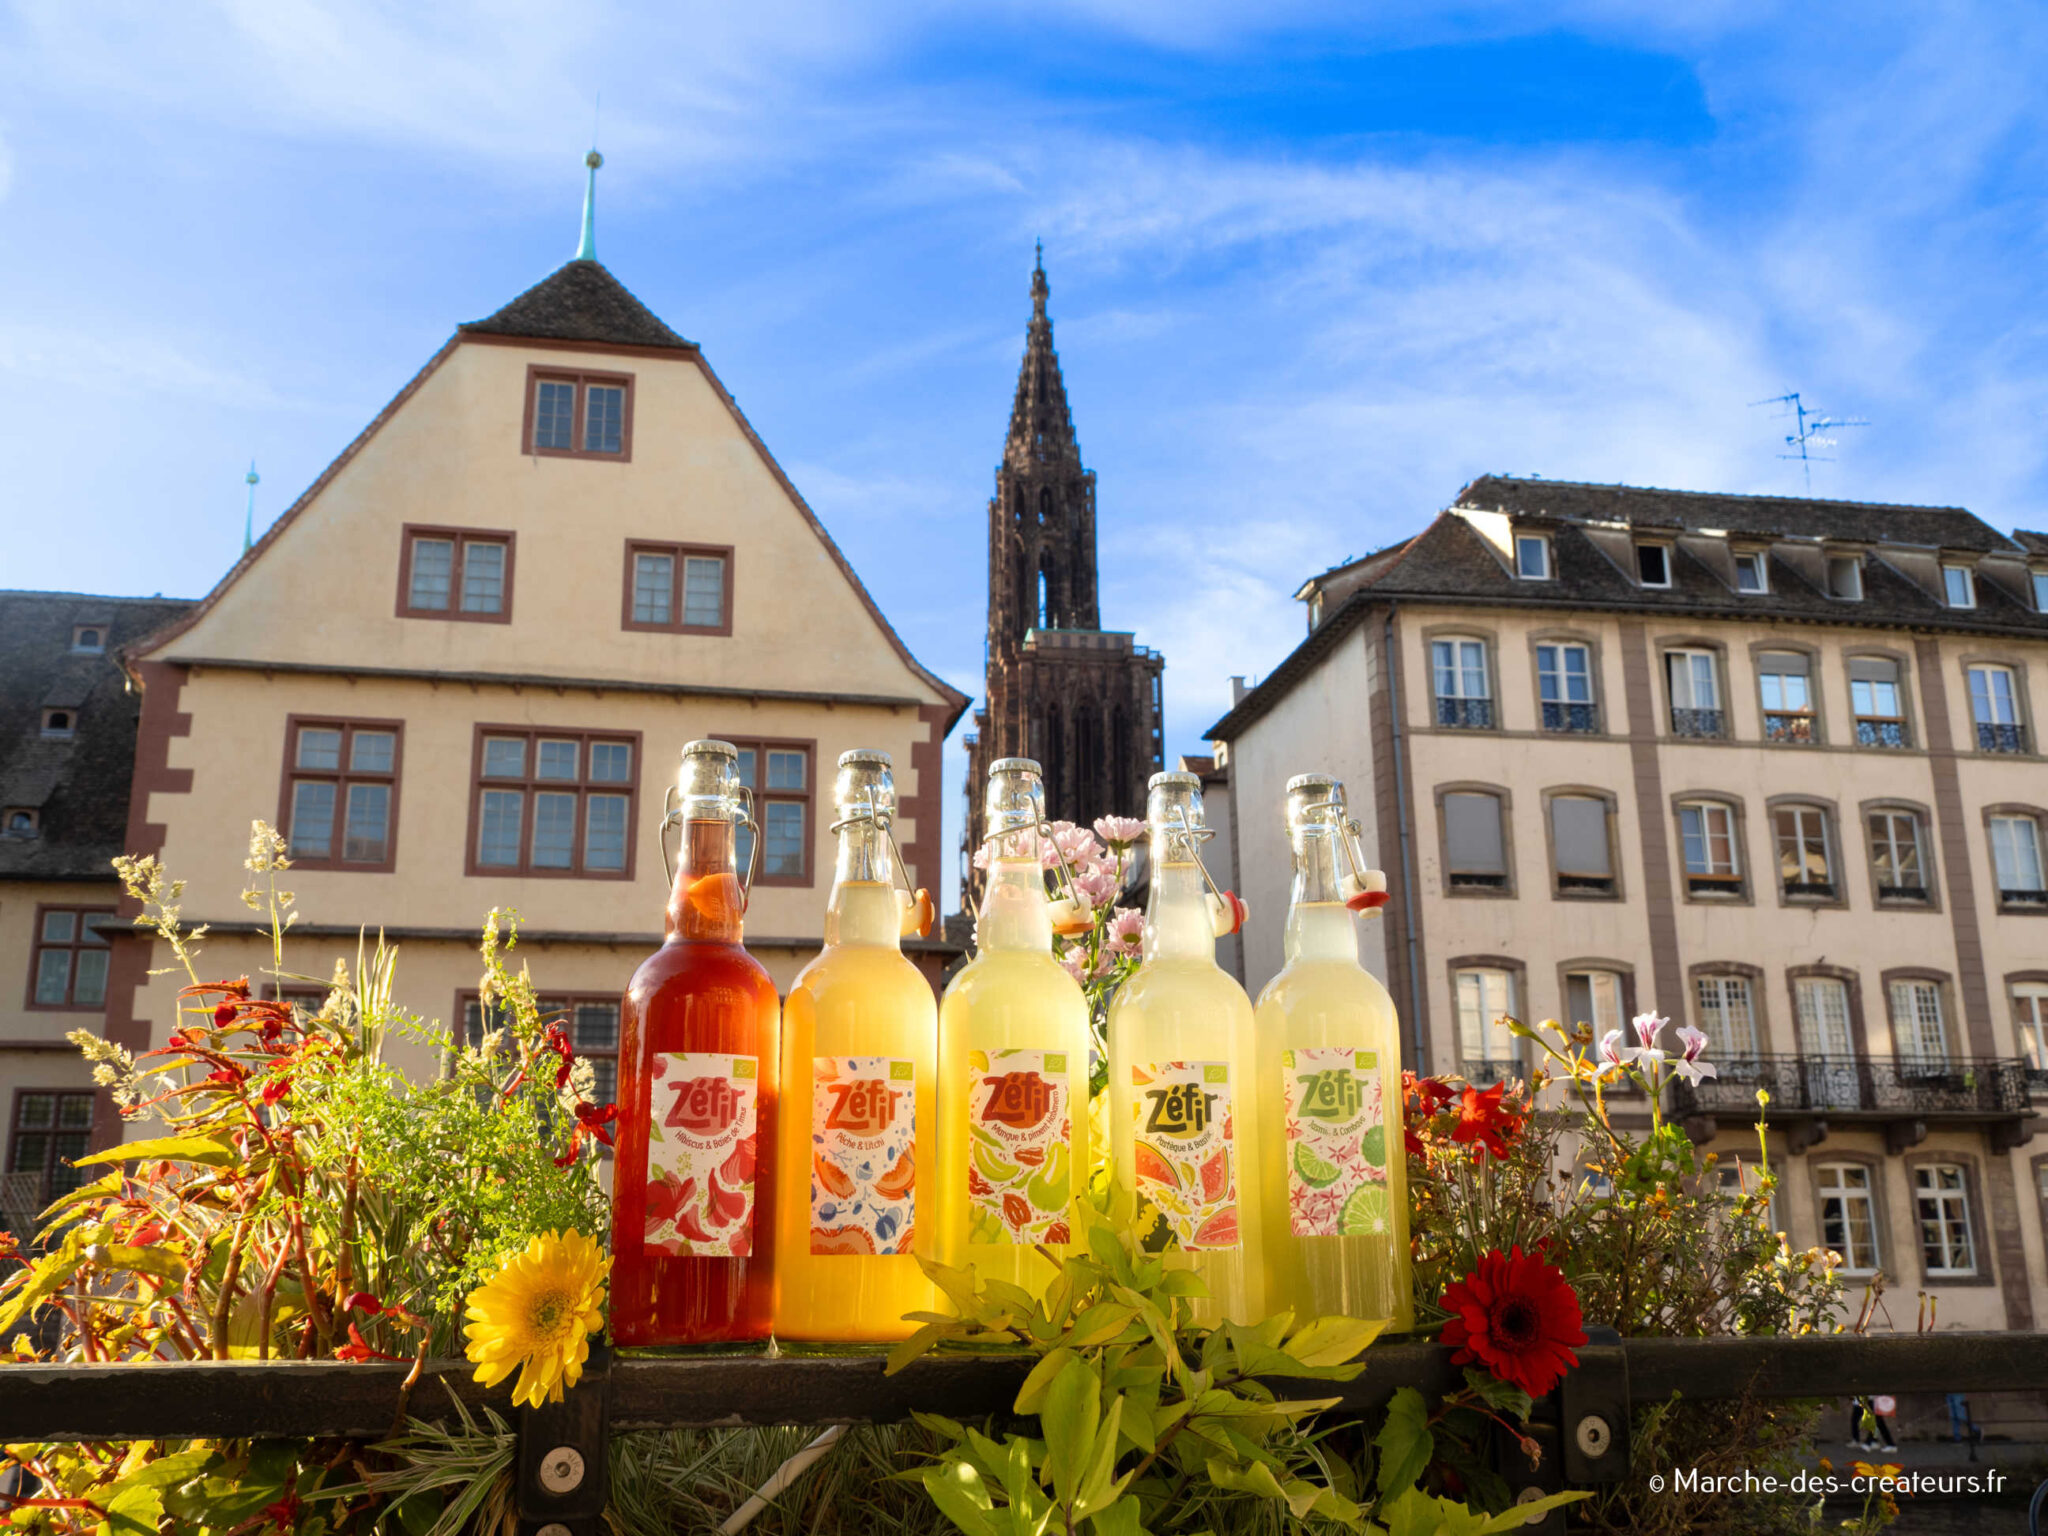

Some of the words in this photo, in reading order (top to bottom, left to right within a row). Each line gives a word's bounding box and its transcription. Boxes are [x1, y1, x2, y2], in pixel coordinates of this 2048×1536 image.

[664, 1076, 746, 1129] Zéfir
[825, 1079, 903, 1130] Zéfir
[981, 1071, 1057, 1122] Zéfir
[1145, 1083, 1218, 1134] Zéfir
[1296, 1069, 1369, 1117] Zéfir
[675, 1130, 704, 1150] Hibiscus
[705, 1141, 712, 1150] &
[713, 1134, 732, 1149] Baies
[731, 1127, 740, 1138] de
[835, 1132, 856, 1149] Pêche
[857, 1141, 863, 1150] &
[865, 1137, 885, 1150] Litchi
[991, 1124, 1019, 1142] Mangue
[1021, 1132, 1026, 1141] &
[1028, 1123, 1049, 1142] piment
[1333, 1128, 1338, 1136] &
[1340, 1115, 1366, 1136] Combava
[1156, 1135, 1186, 1152] Pastèque
[1188, 1142, 1194, 1151] &
